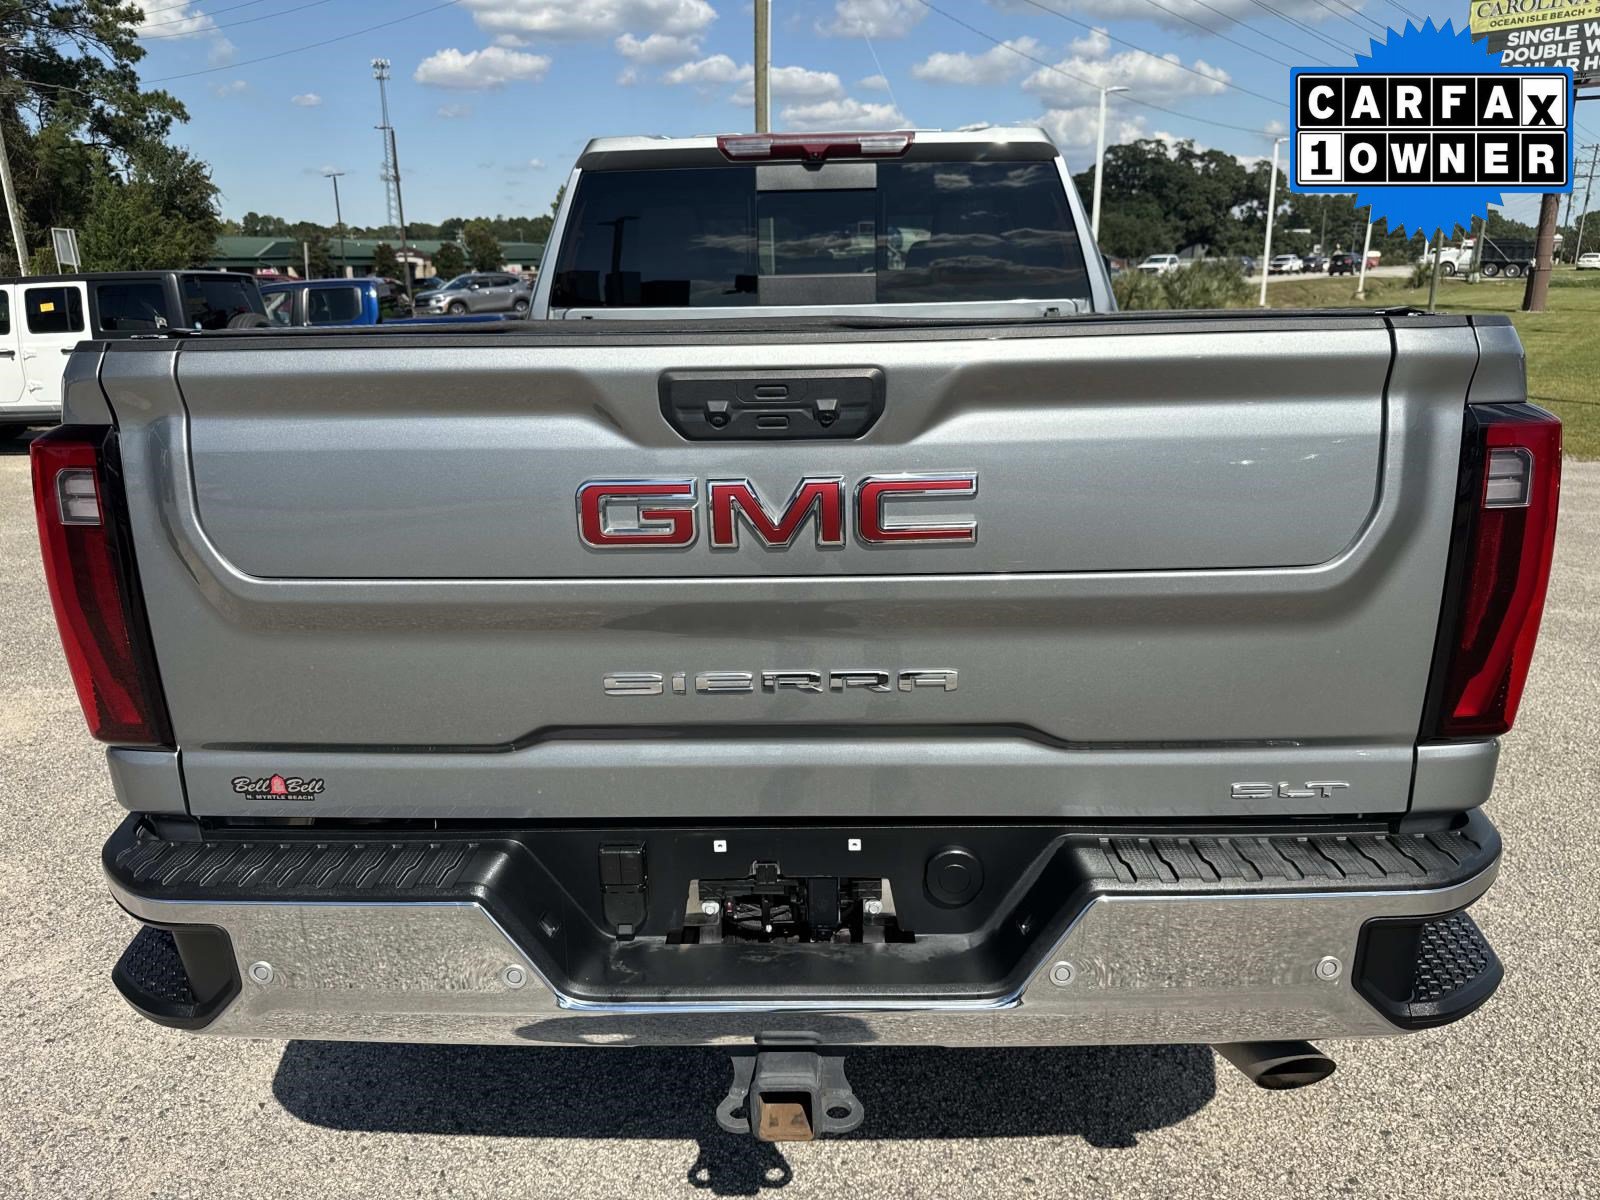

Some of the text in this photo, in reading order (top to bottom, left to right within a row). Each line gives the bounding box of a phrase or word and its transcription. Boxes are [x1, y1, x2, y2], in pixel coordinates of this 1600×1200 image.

[1477, 0, 1590, 18] CAROLI
[1489, 17, 1525, 28] OCEAN
[1526, 13, 1550, 24] ISLE
[1550, 8, 1586, 20] BEACH
[1506, 24, 1580, 47] SINGLE
[1501, 40, 1582, 64] DOUBLE
[576, 471, 979, 551] GMC
[602, 668, 960, 696] SIERRA
[233, 777, 270, 793] Bell
[286, 778, 324, 793] Bell
[1231, 780, 1350, 799] SLT
